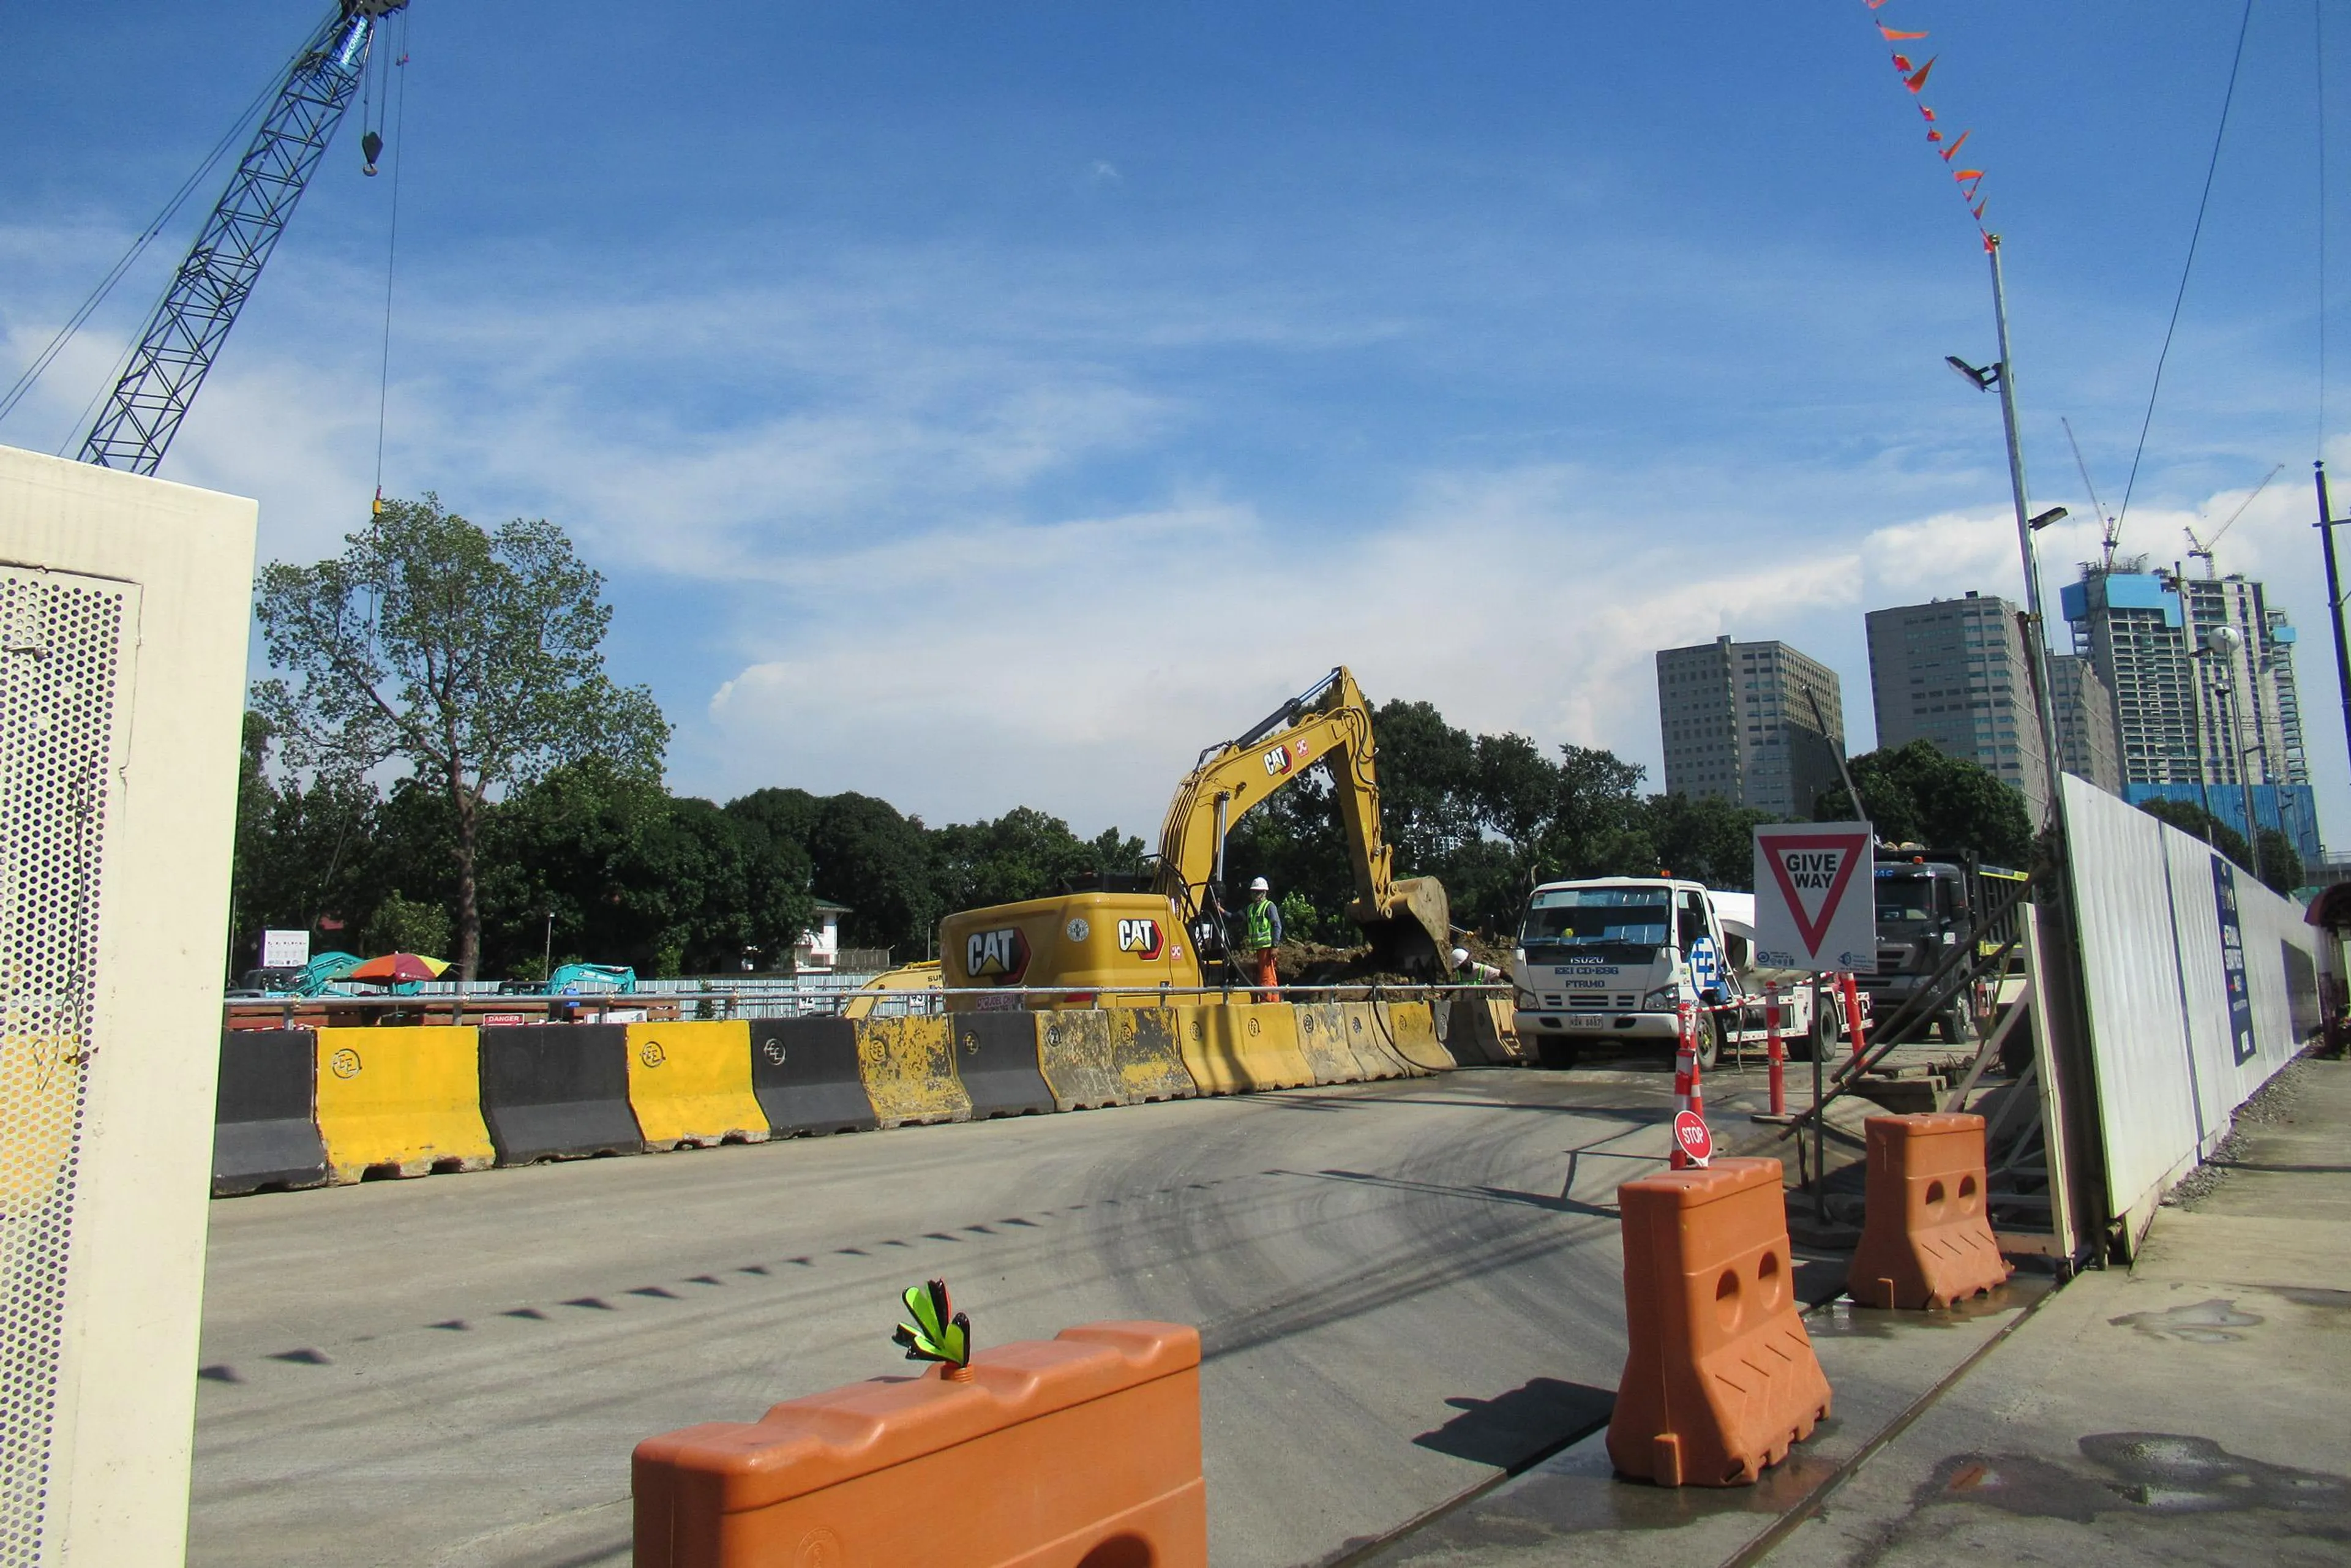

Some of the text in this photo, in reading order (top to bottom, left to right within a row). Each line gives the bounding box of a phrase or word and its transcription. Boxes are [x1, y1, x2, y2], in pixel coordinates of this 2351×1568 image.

[348, 21, 366, 50] CRANES
[1264, 746, 1286, 775] CAT
[1786, 854, 1837, 872] GIVE
[1794, 874, 1834, 888] WAY
[1119, 920, 1152, 951] CAT
[968, 929, 1014, 976] CAT
[1682, 1127, 1704, 1144] STOP
